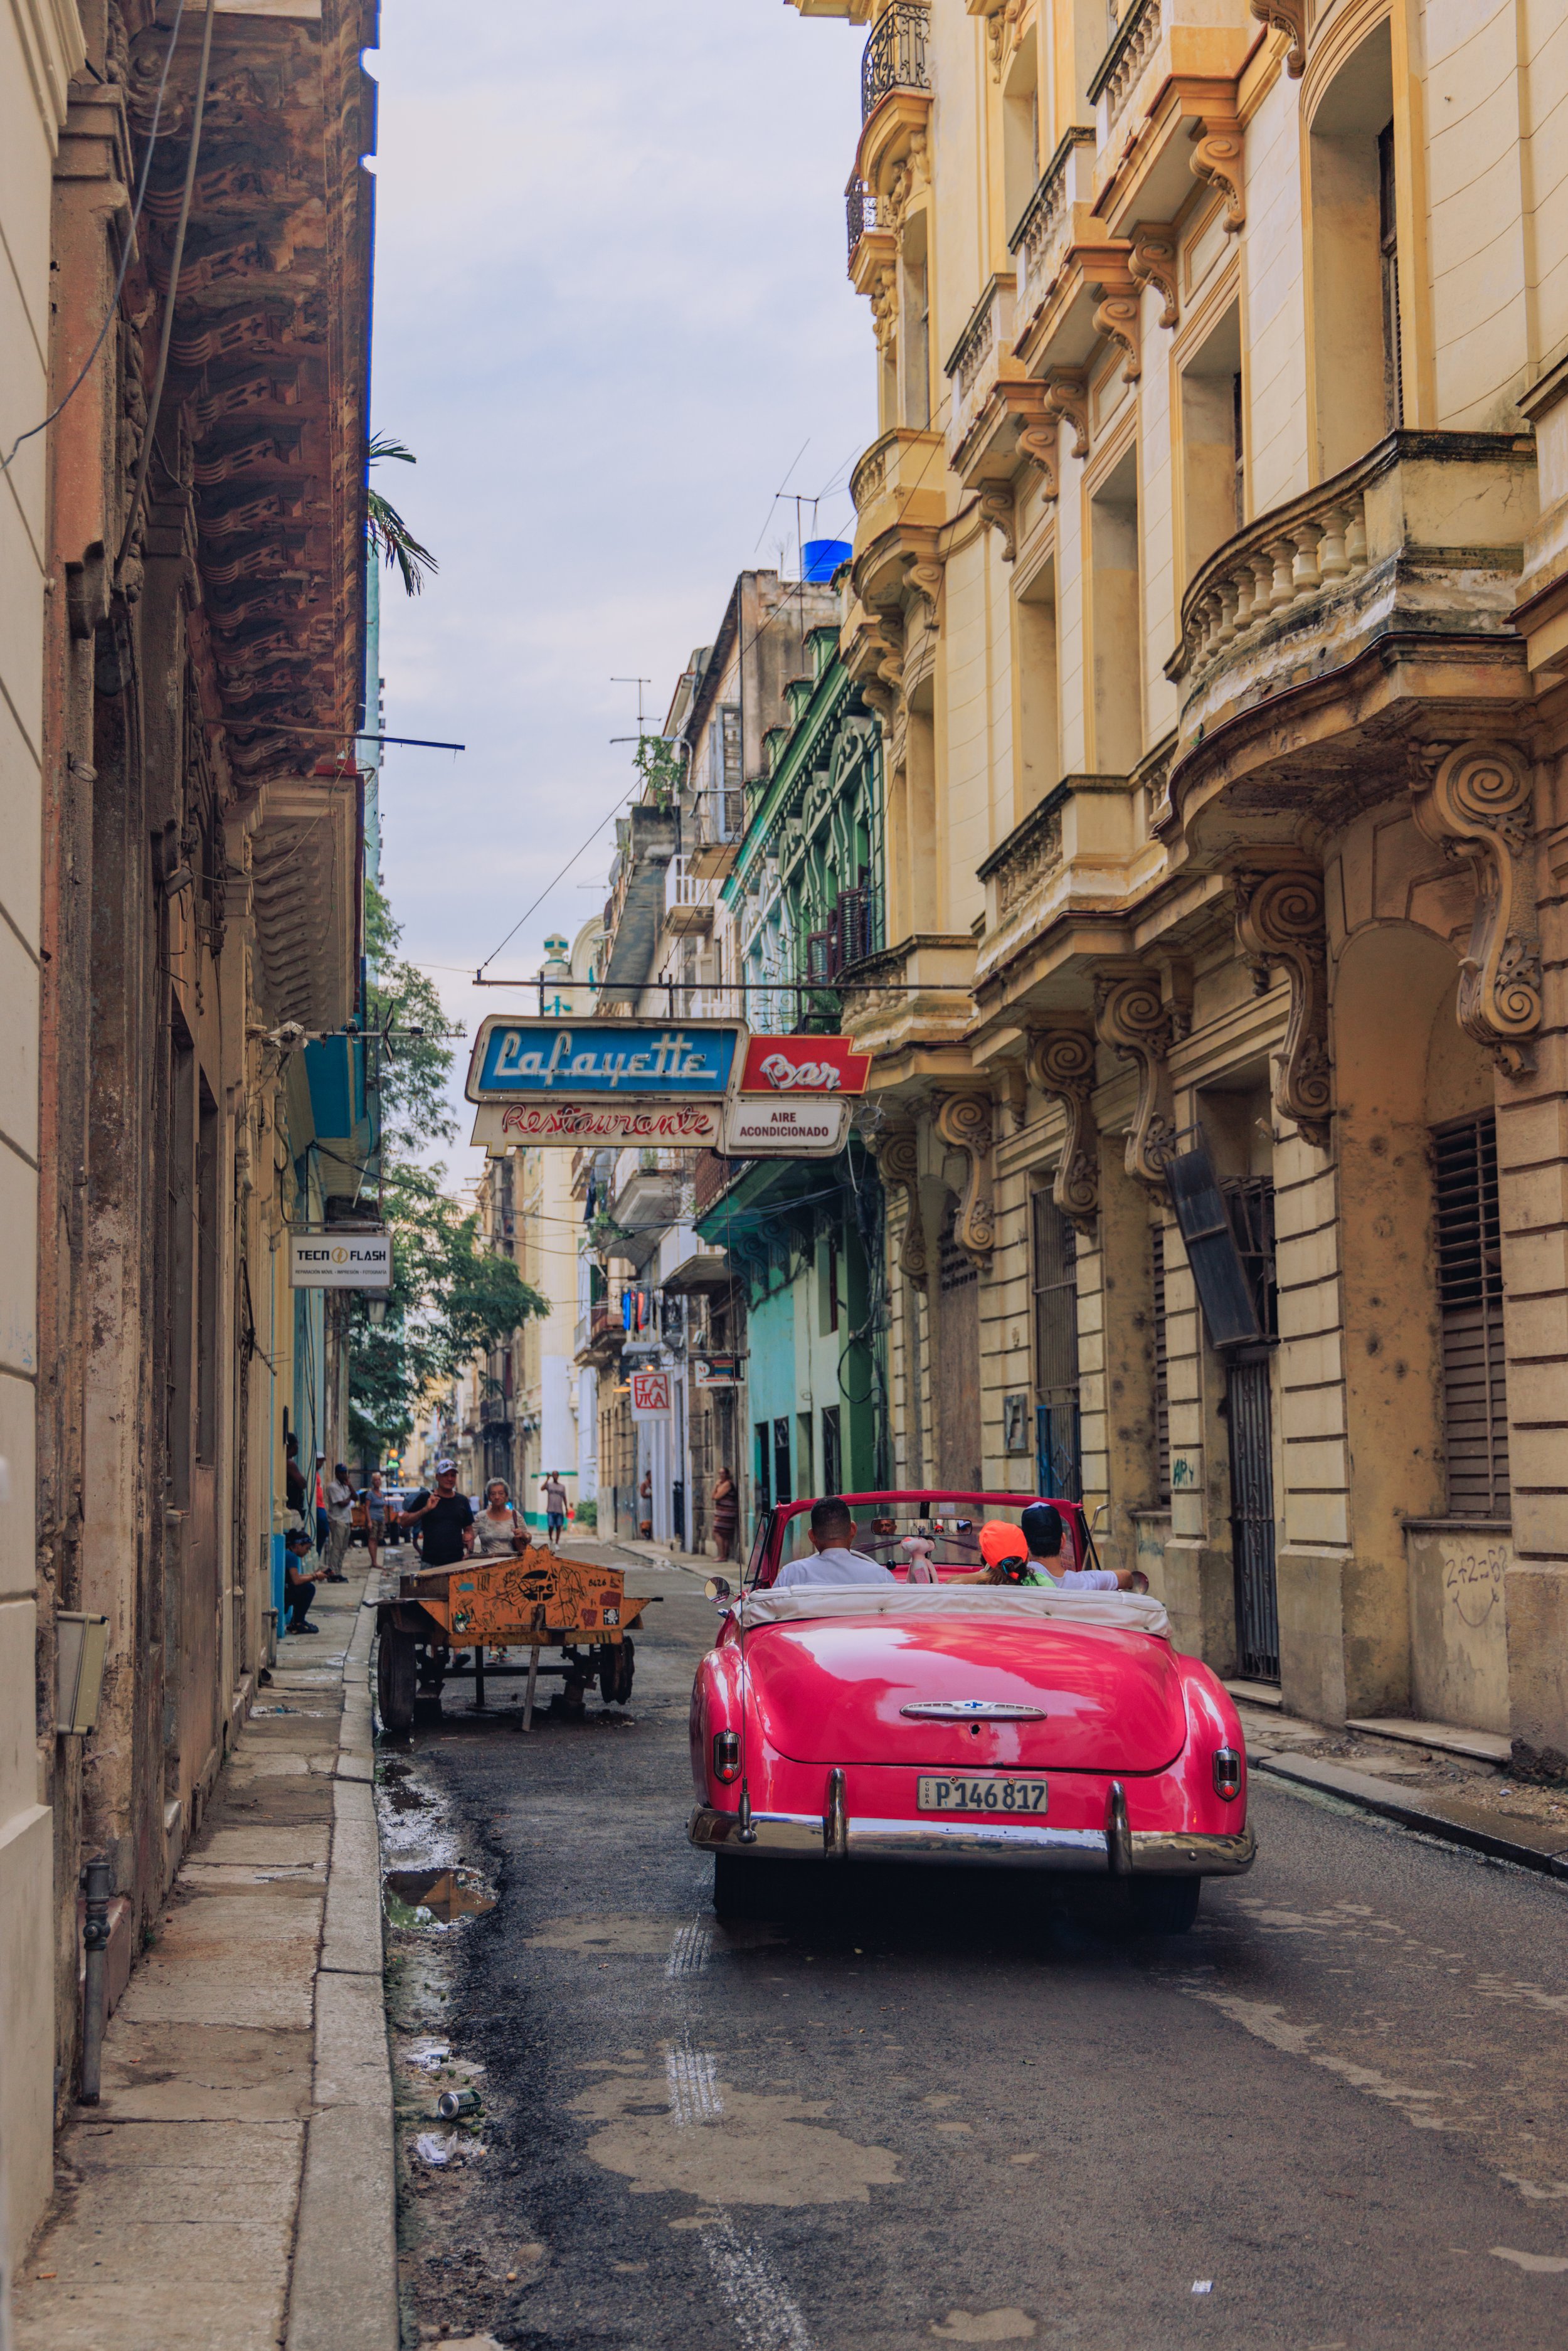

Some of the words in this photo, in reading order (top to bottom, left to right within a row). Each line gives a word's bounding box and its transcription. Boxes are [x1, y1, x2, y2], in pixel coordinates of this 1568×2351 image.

[759, 1053, 842, 1091] Bar
[502, 1103, 714, 1135] Restaurante
[771, 1113, 797, 1123] AIRE
[739, 1127, 829, 1137] ACONDICIONADO
[350, 1250, 386, 1261] FLASH
